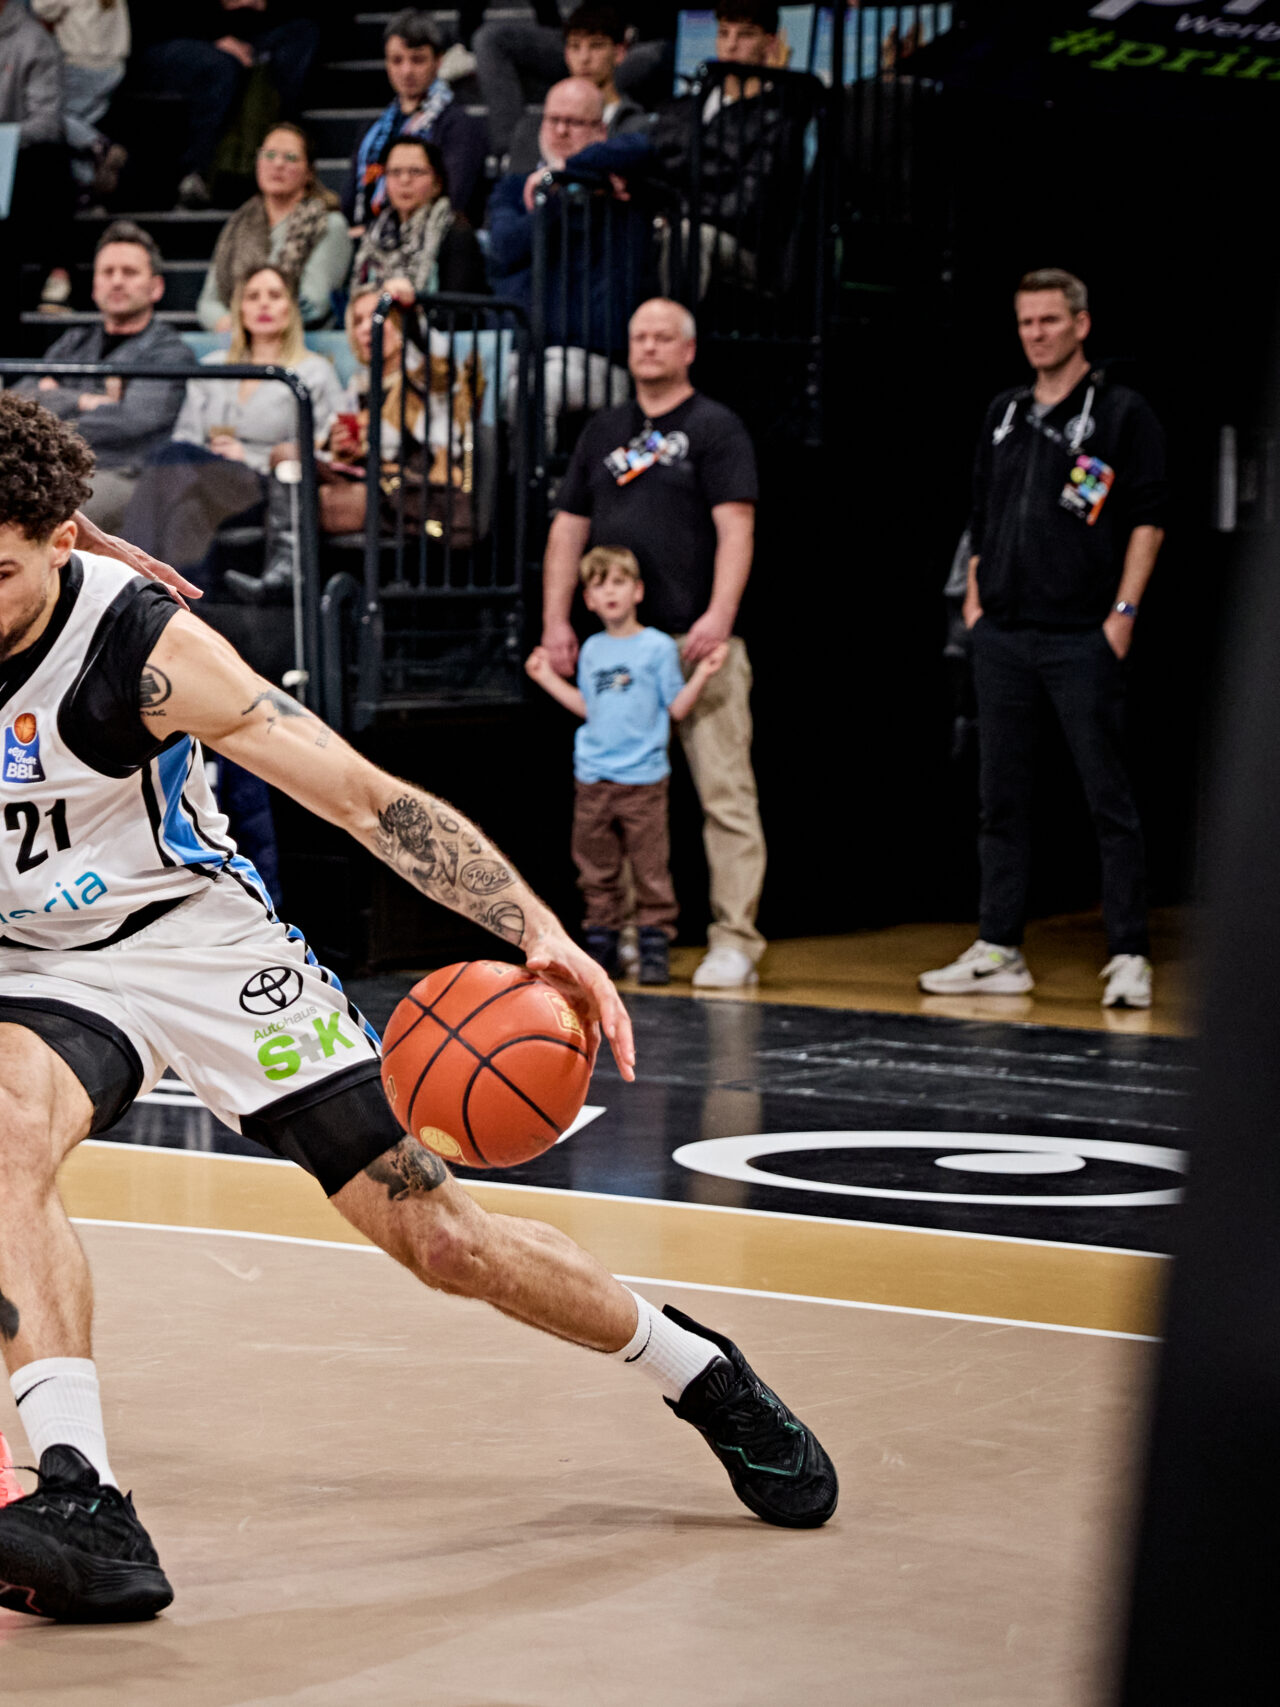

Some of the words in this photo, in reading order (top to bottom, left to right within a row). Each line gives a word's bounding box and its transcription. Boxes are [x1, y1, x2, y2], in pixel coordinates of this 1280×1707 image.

[6, 762, 40, 779] BBL
[4, 798, 72, 875] 21
[254, 1006, 317, 1043] Autohaus
[257, 1011, 355, 1081] S+K
